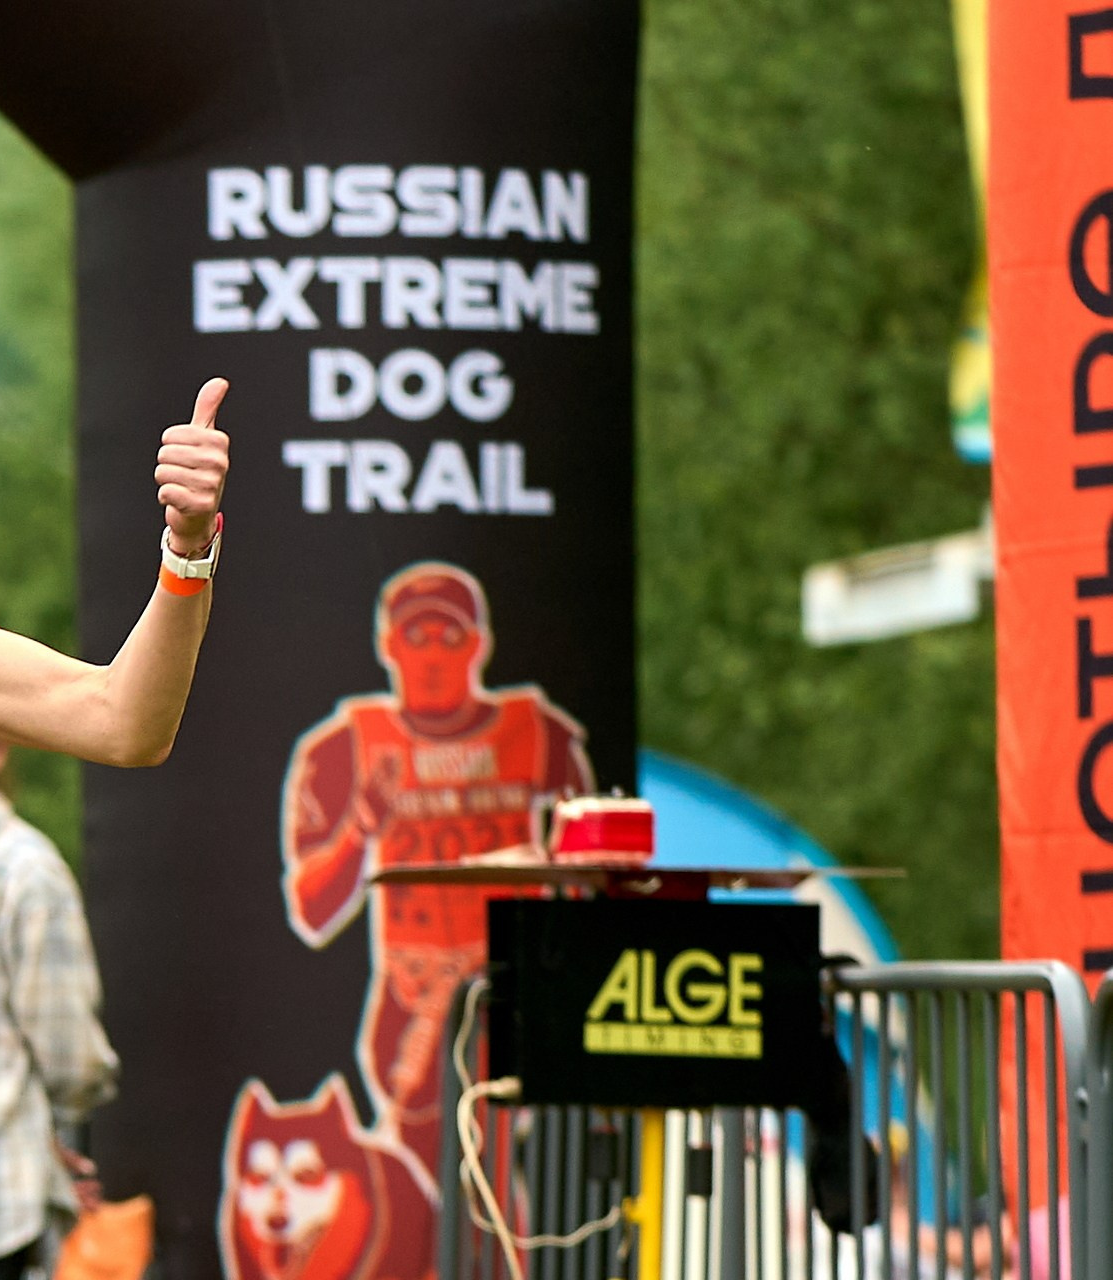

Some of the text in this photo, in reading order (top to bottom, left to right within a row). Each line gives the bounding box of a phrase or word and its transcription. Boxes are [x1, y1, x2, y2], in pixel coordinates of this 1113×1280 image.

[207, 164, 589, 243] RUSSIAN
[192, 256, 601, 335] EXTREME
[308, 347, 514, 423] DOG
[282, 440, 555, 516] TRAIL
[587, 948, 763, 1026] ALGE
